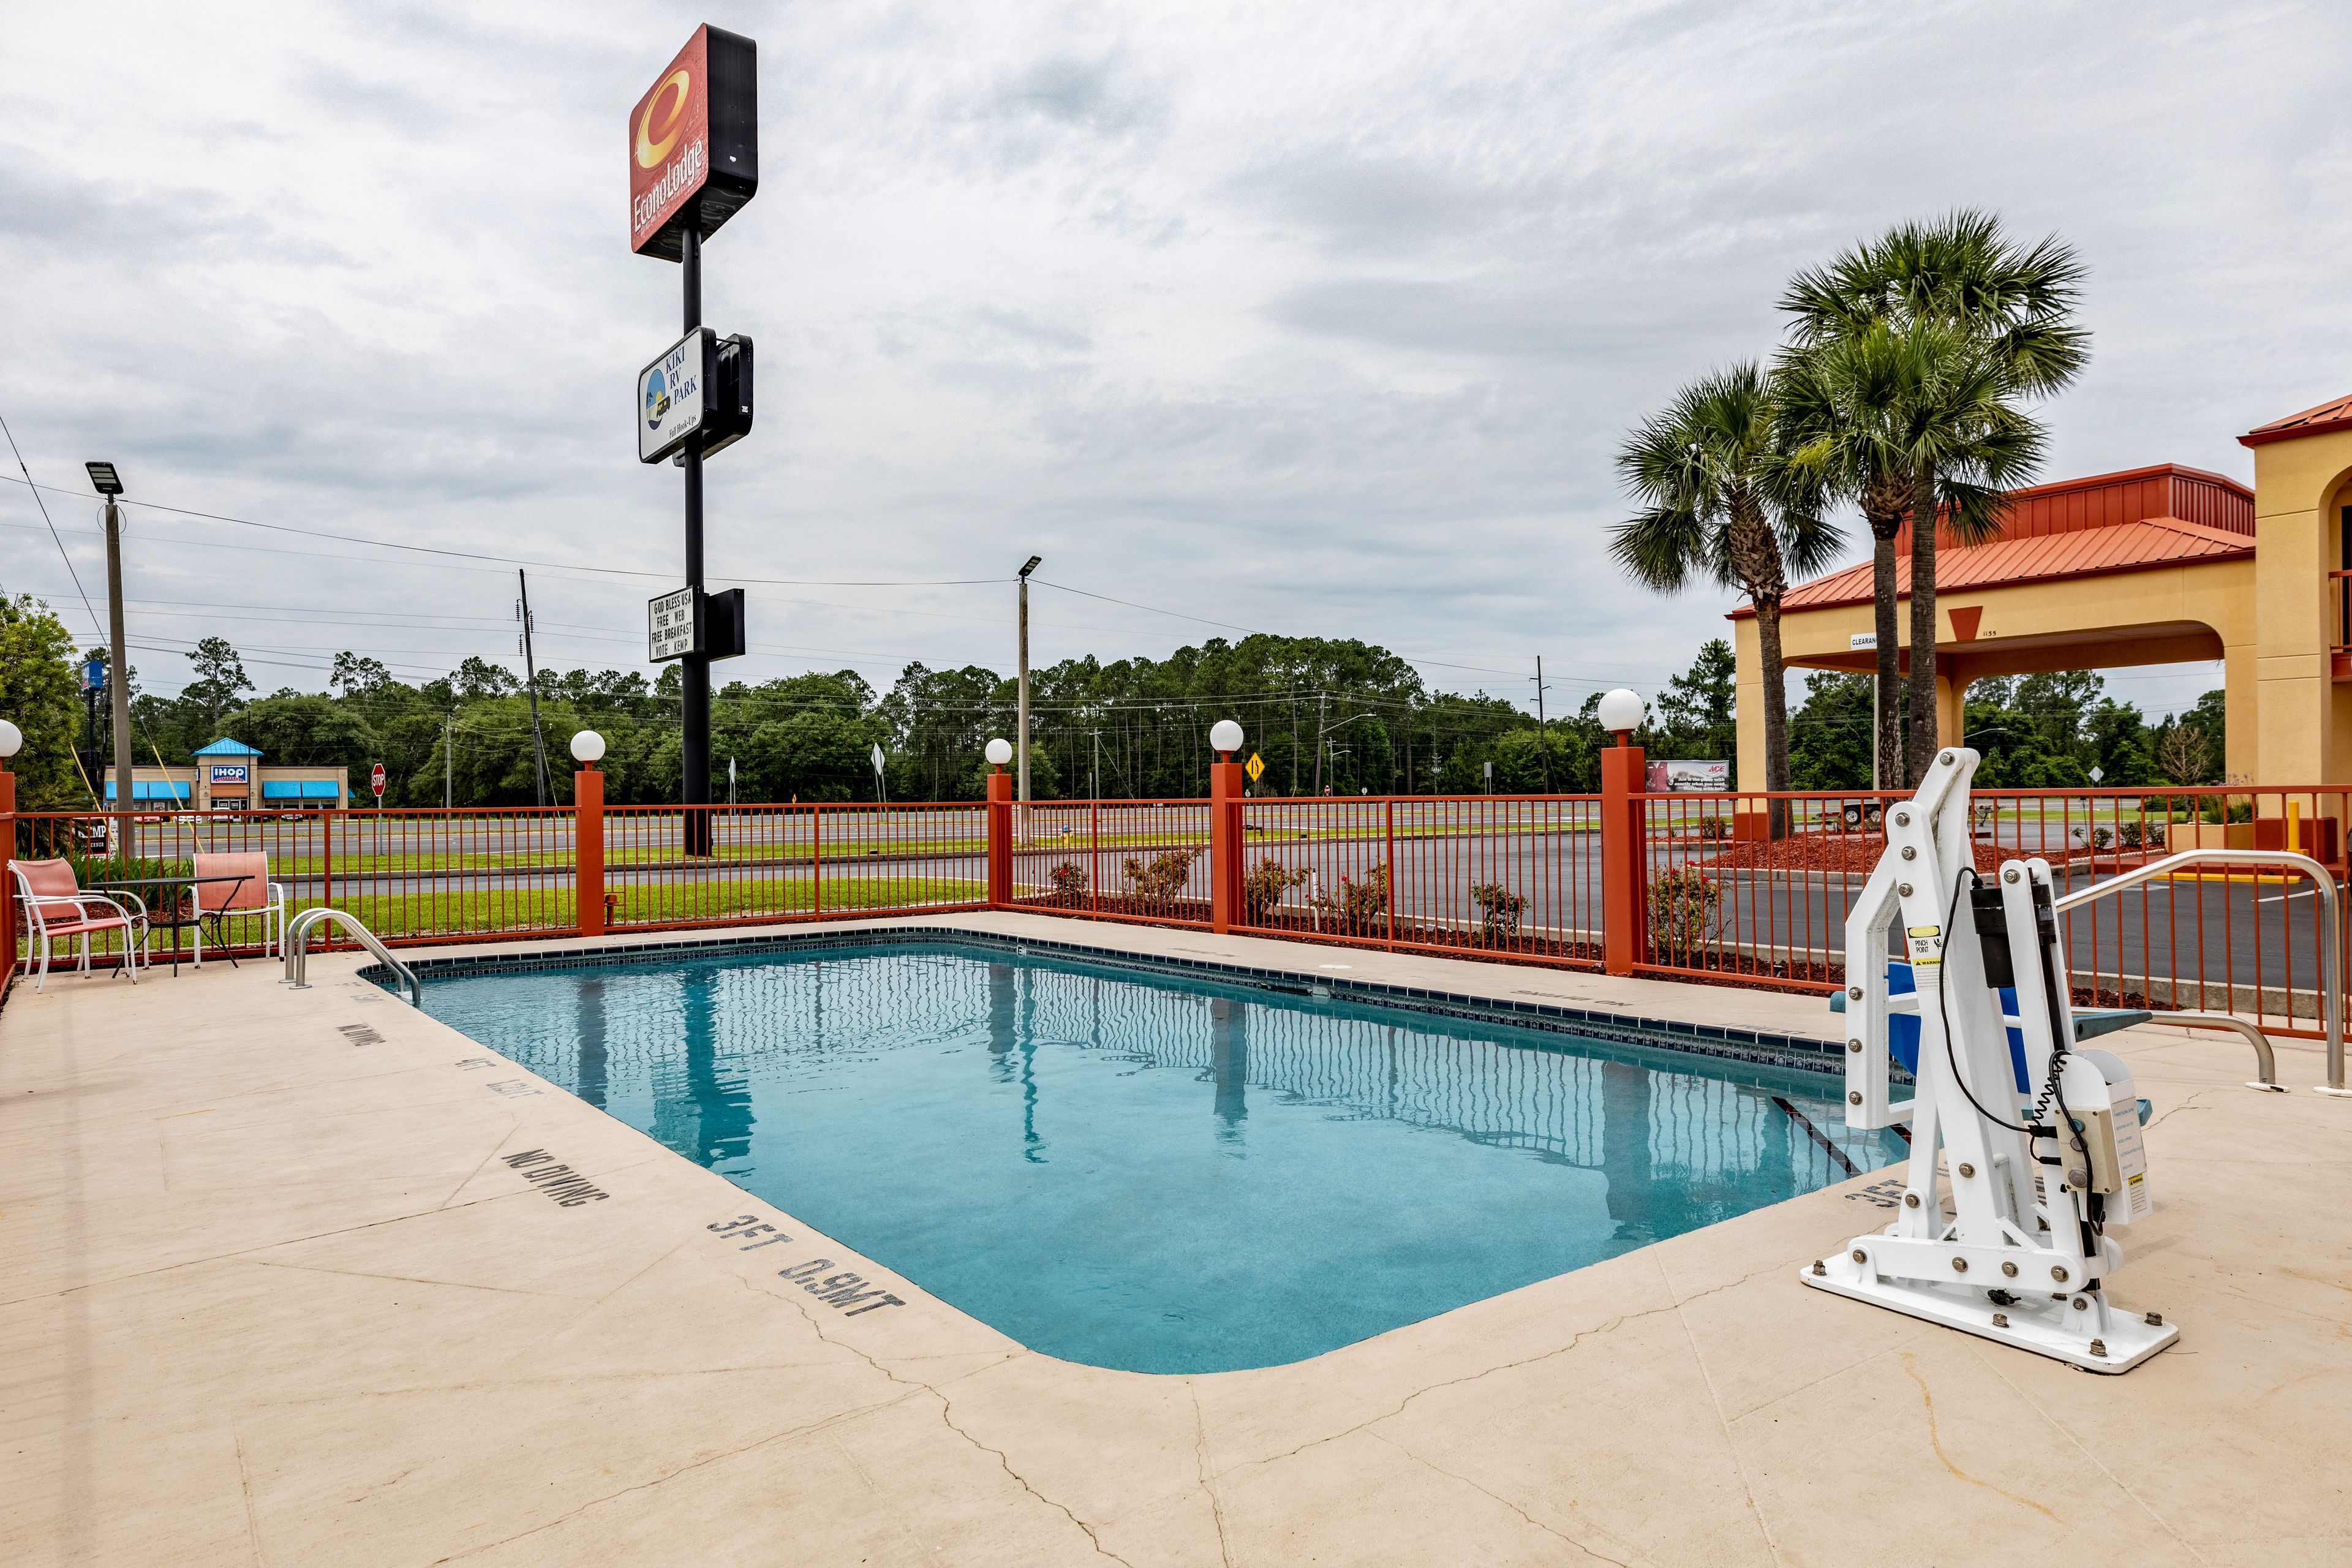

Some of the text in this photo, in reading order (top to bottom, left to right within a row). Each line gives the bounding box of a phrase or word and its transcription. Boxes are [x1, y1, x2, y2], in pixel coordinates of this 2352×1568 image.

[666, 345, 685, 374] KIKI
[670, 368, 680, 390] RV
[674, 375, 697, 405] PARK
[677, 415, 696, 433] Hook-Ups
[654, 592, 692, 614] GOD BLESS USA
[657, 609, 684, 628] FREE WEB
[652, 622, 692, 644] FREE BREAKFAST
[1852, 637, 1877, 646] CLEARAN
[656, 639, 687, 657] VOTE KEMP
[214, 768, 244, 778] IHOP
[372, 774, 384, 786] STOP
[78, 825, 107, 839] MP
[500, 1148, 610, 1208] NO DIVING
[706, 1215, 794, 1251] 3FT
[778, 1259, 907, 1317] 0.9MT
